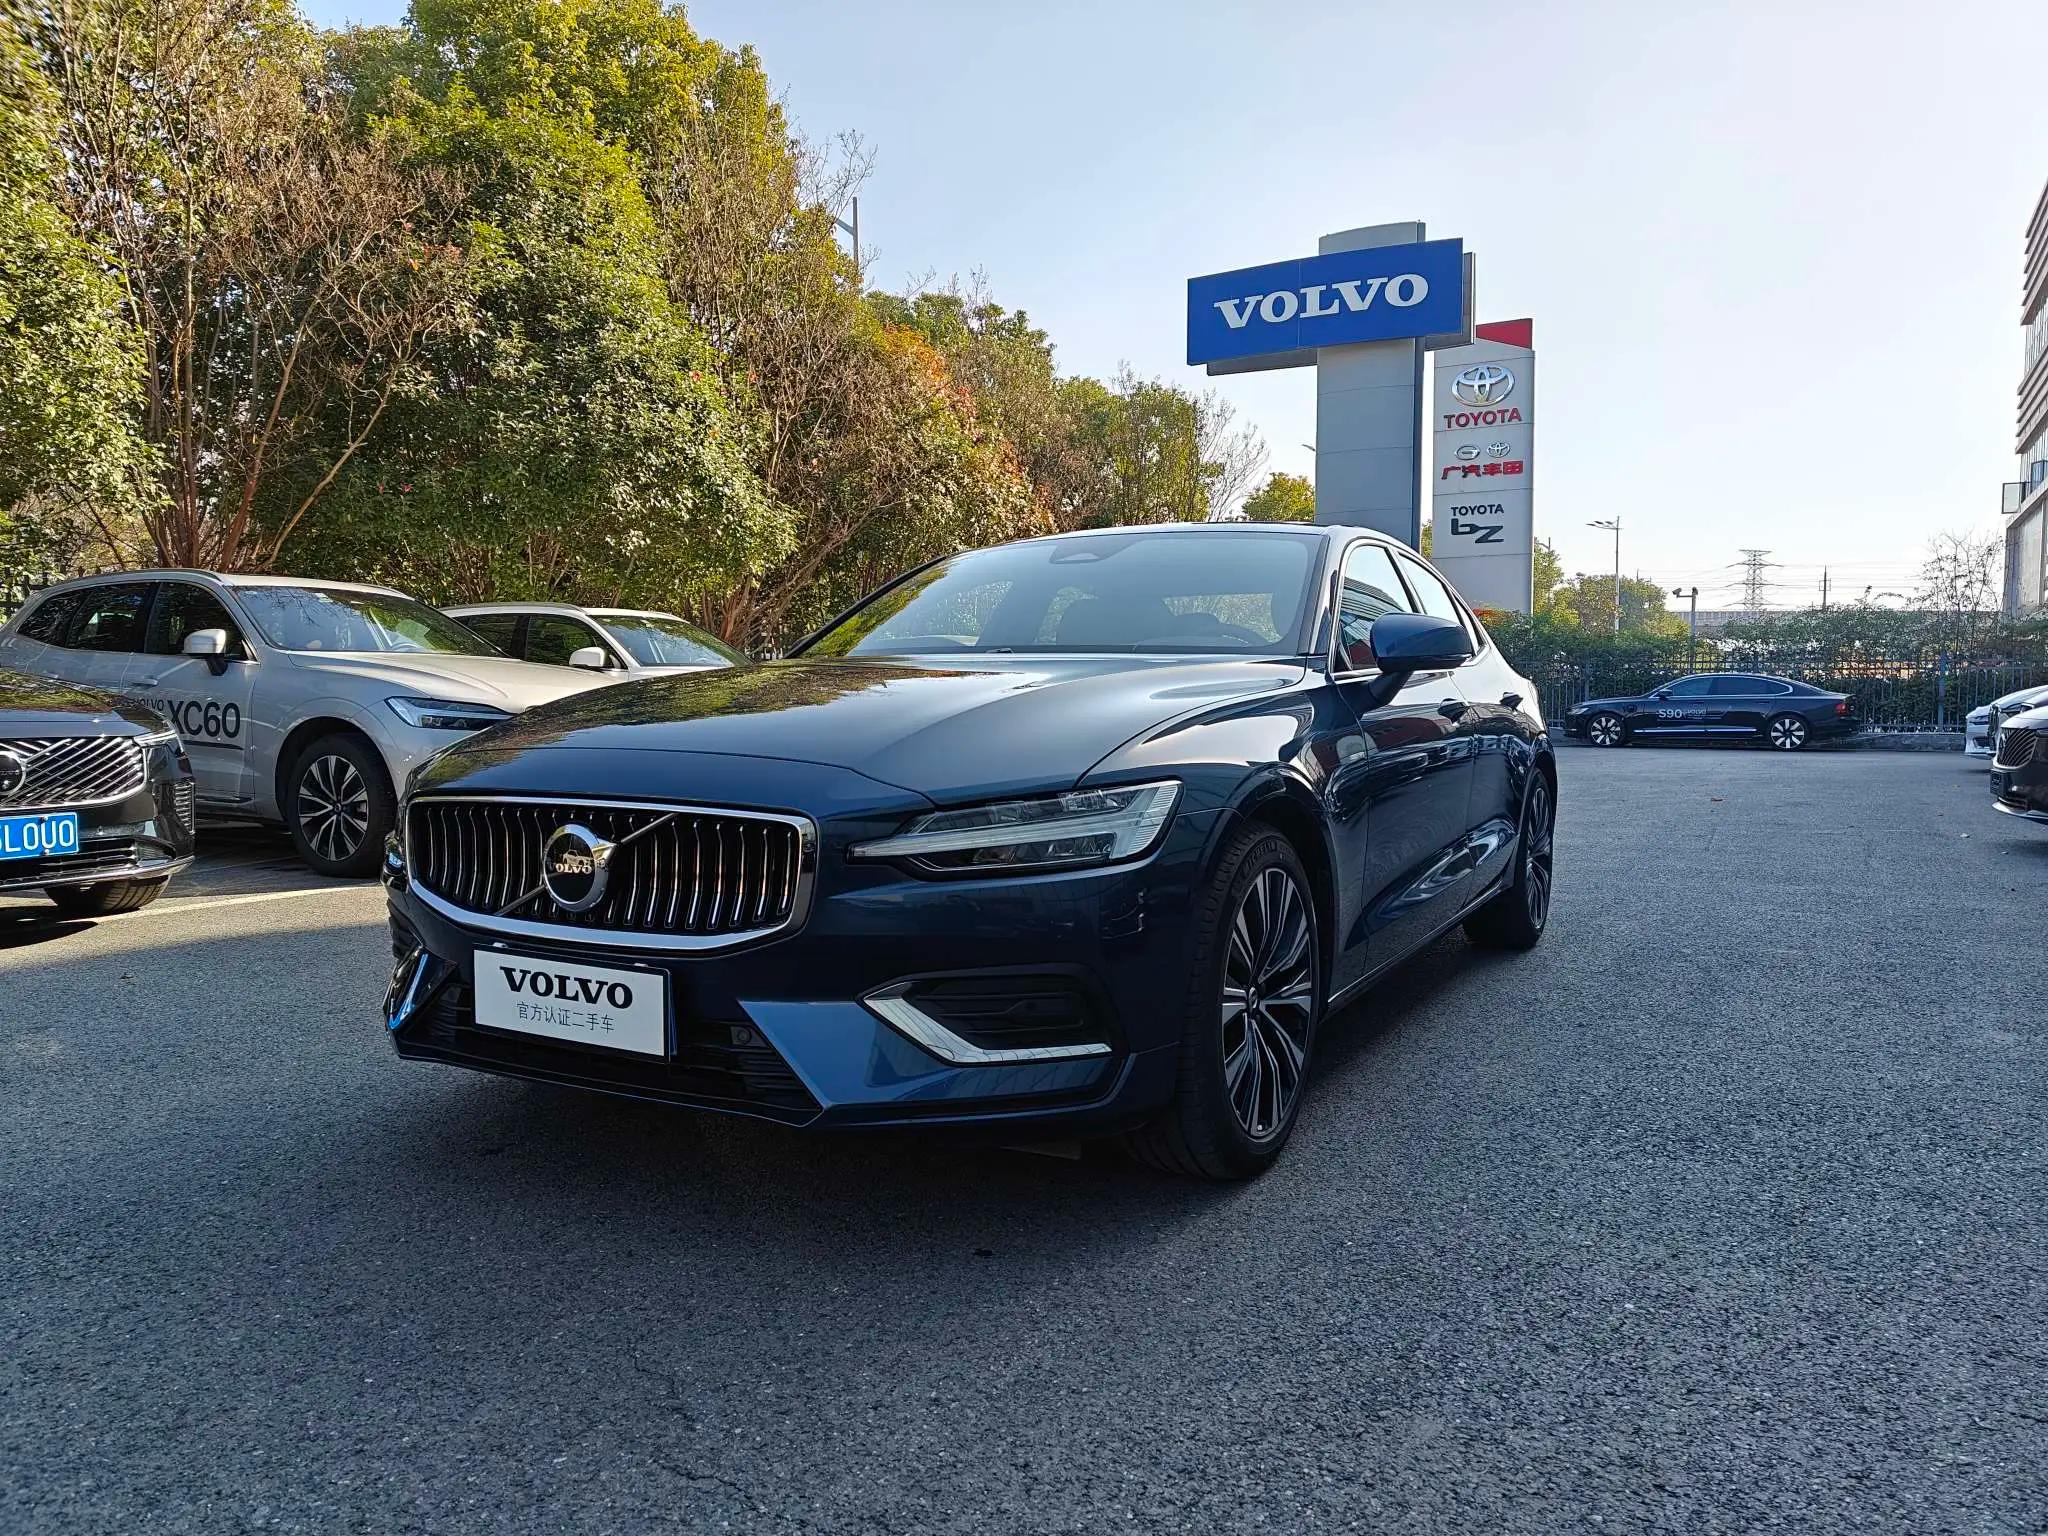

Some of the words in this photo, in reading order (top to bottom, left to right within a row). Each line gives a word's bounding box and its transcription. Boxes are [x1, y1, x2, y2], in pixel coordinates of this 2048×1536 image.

[1214, 273, 1429, 329] VOLVO
[1443, 407, 1522, 429] TOYOTA
[1450, 503, 1505, 517] TOYOTA
[167, 699, 241, 739] XC60
[1659, 709, 1683, 719] S90
[547, 861, 593, 874] VOLVO
[499, 966, 633, 1009] VOLVO
[516, 1001, 615, 1034] 官方认证二手车
